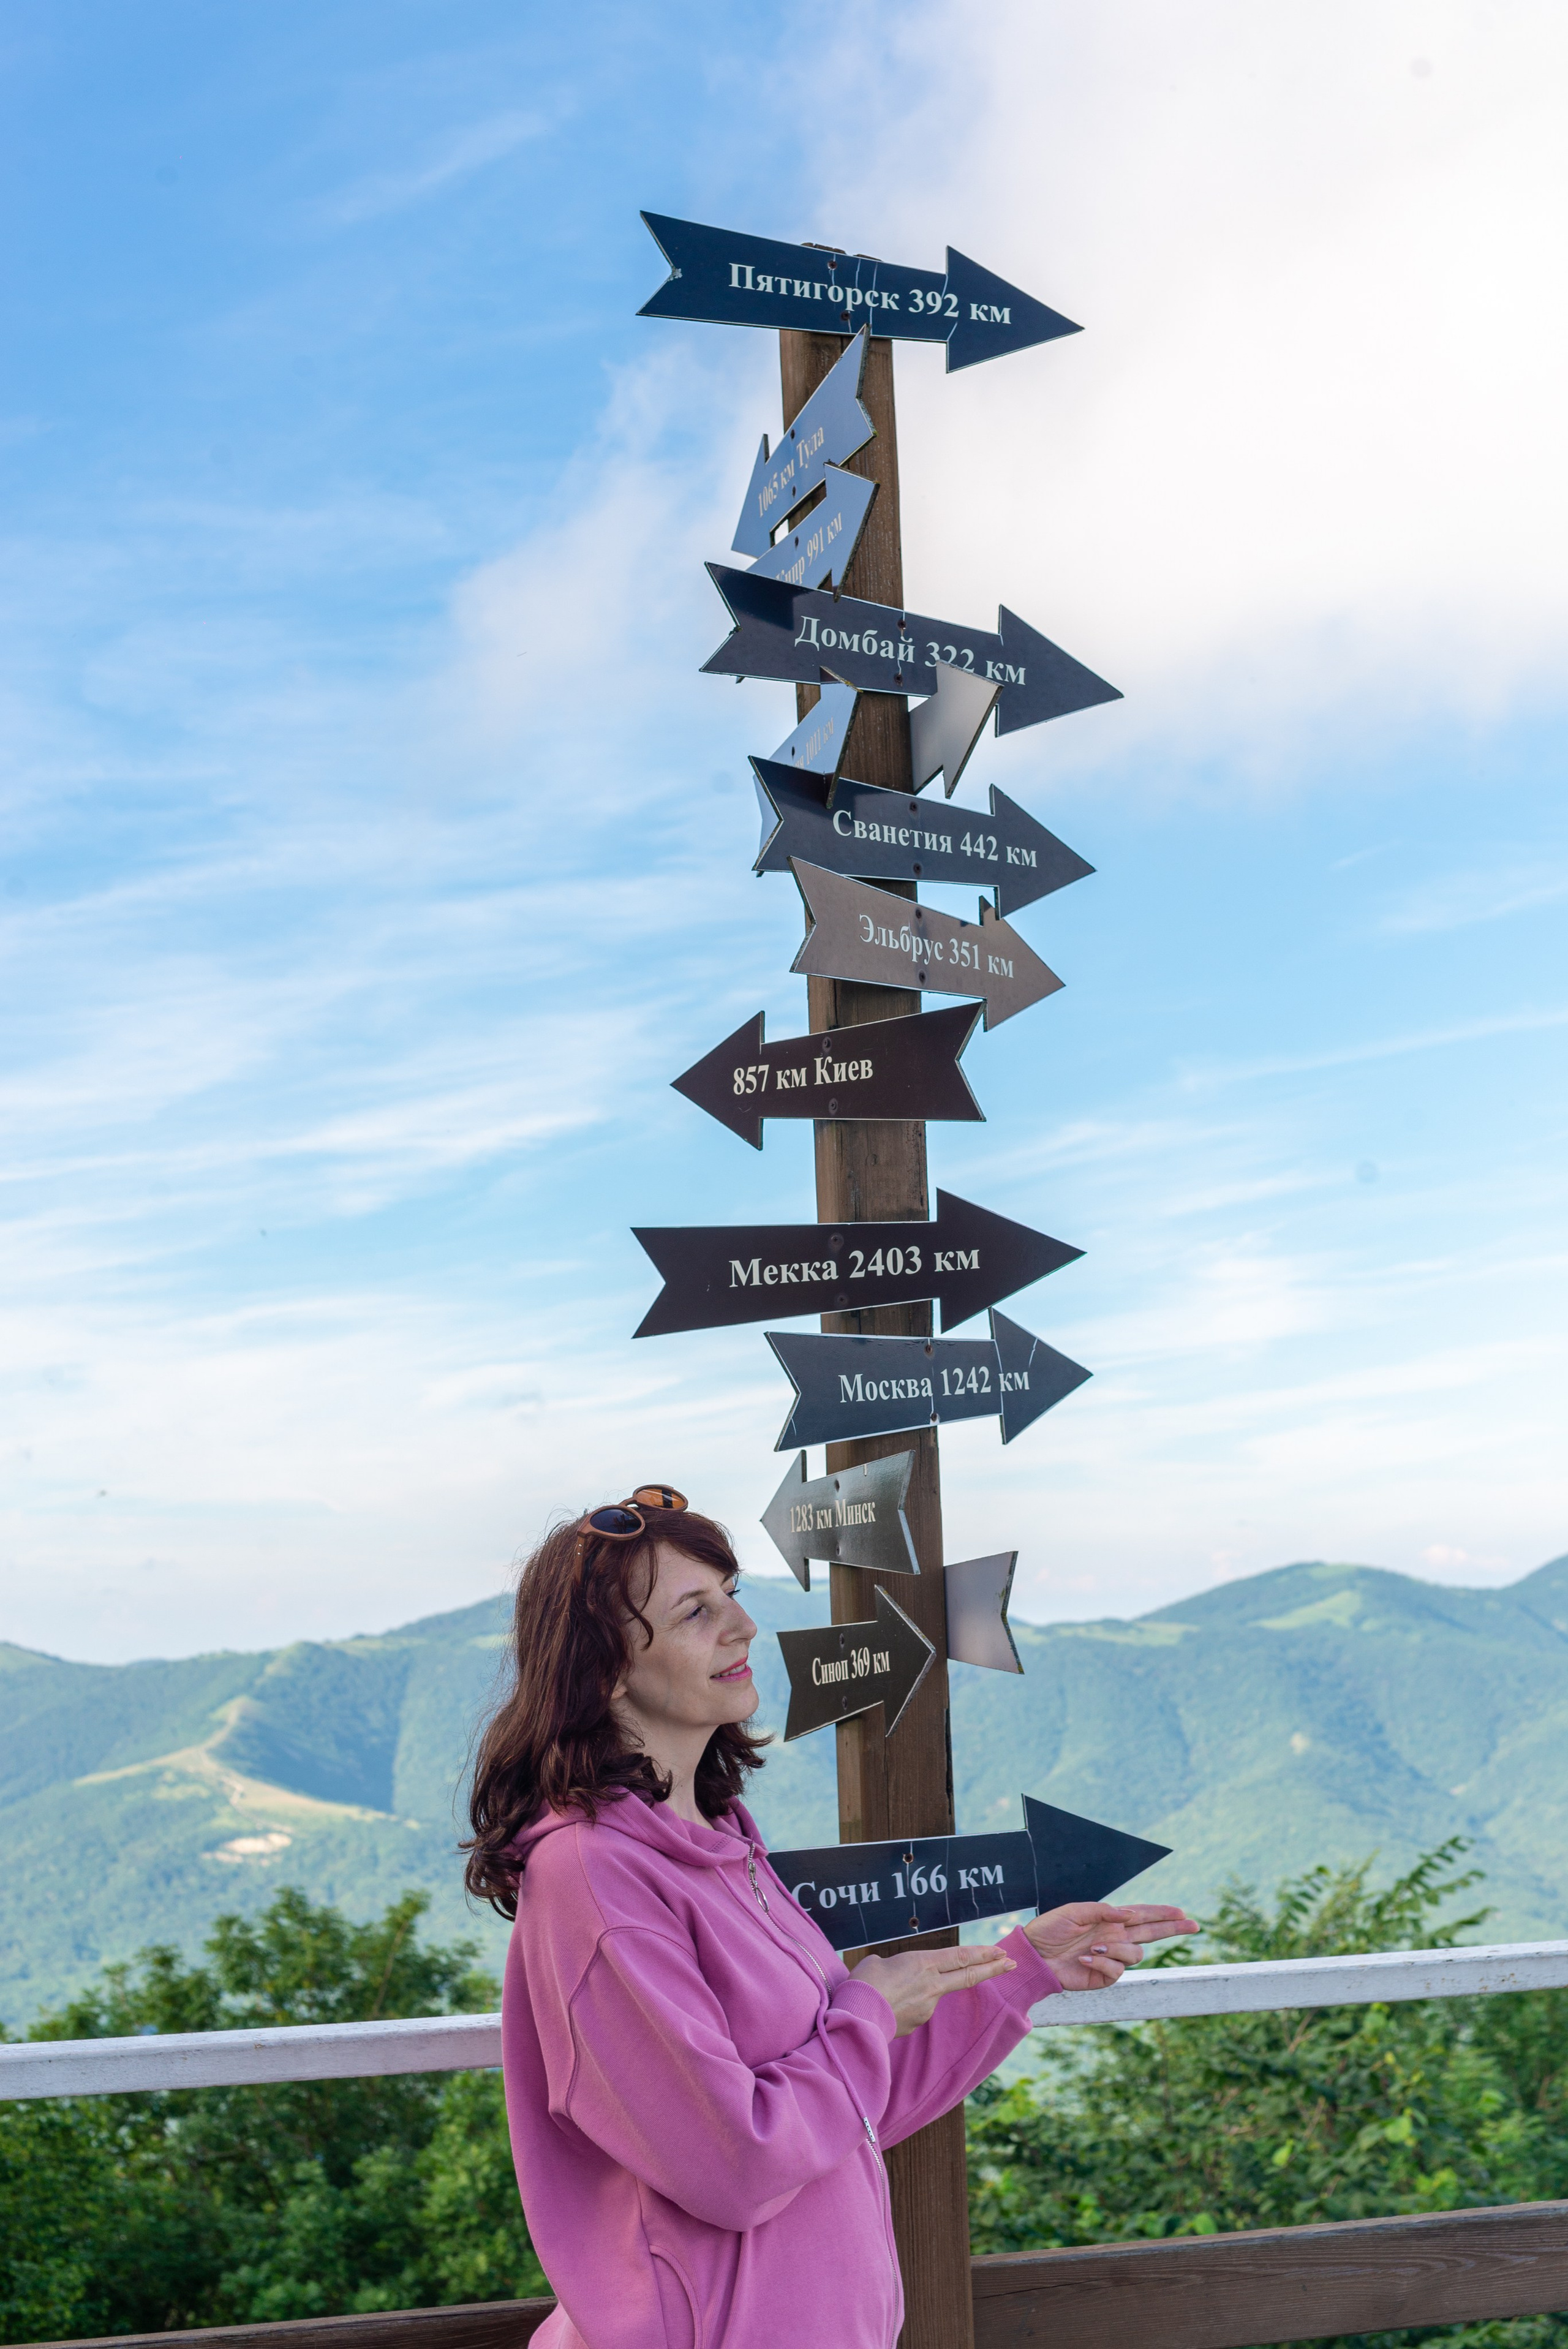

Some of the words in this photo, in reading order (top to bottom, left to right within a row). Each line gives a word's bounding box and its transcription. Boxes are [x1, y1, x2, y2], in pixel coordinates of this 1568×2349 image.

[728, 262, 900, 311] Пятигорск
[908, 288, 959, 318] 392
[970, 303, 1012, 325] км
[758, 472, 778, 518] 1065
[780, 459, 795, 489] км
[796, 427, 824, 469] Тула
[807, 526, 824, 567] 991
[827, 512, 842, 545] км
[794, 616, 915, 663] Домбай
[985, 660, 1026, 685] км
[823, 715, 834, 745] км
[832, 810, 952, 854] Сванетия
[960, 832, 998, 861] 442
[1006, 845, 1038, 868] км
[859, 914, 943, 965] Эльбрус
[949, 938, 981, 971] 351
[987, 954, 1014, 978] км
[733, 1065, 769, 1095] 857
[776, 1066, 807, 1090] км
[813, 1056, 873, 1085] Киев
[729, 1257, 839, 1288] Мекка
[849, 1245, 921, 1279] 2403
[934, 1248, 981, 1272] км
[838, 1374, 933, 1403] Москва
[941, 1366, 992, 1397] 1242
[998, 1371, 1030, 1392] км
[790, 1503, 813, 1533] 1283
[816, 1509, 832, 1529] км
[835, 1498, 876, 1527] Минск
[812, 1657, 849, 1686] Синоп
[850, 1646, 870, 1678] 369
[873, 1651, 891, 1673] км
[793, 1881, 881, 1912] Сочи
[892, 1864, 948, 1899] 166
[958, 1864, 1005, 1890] км
